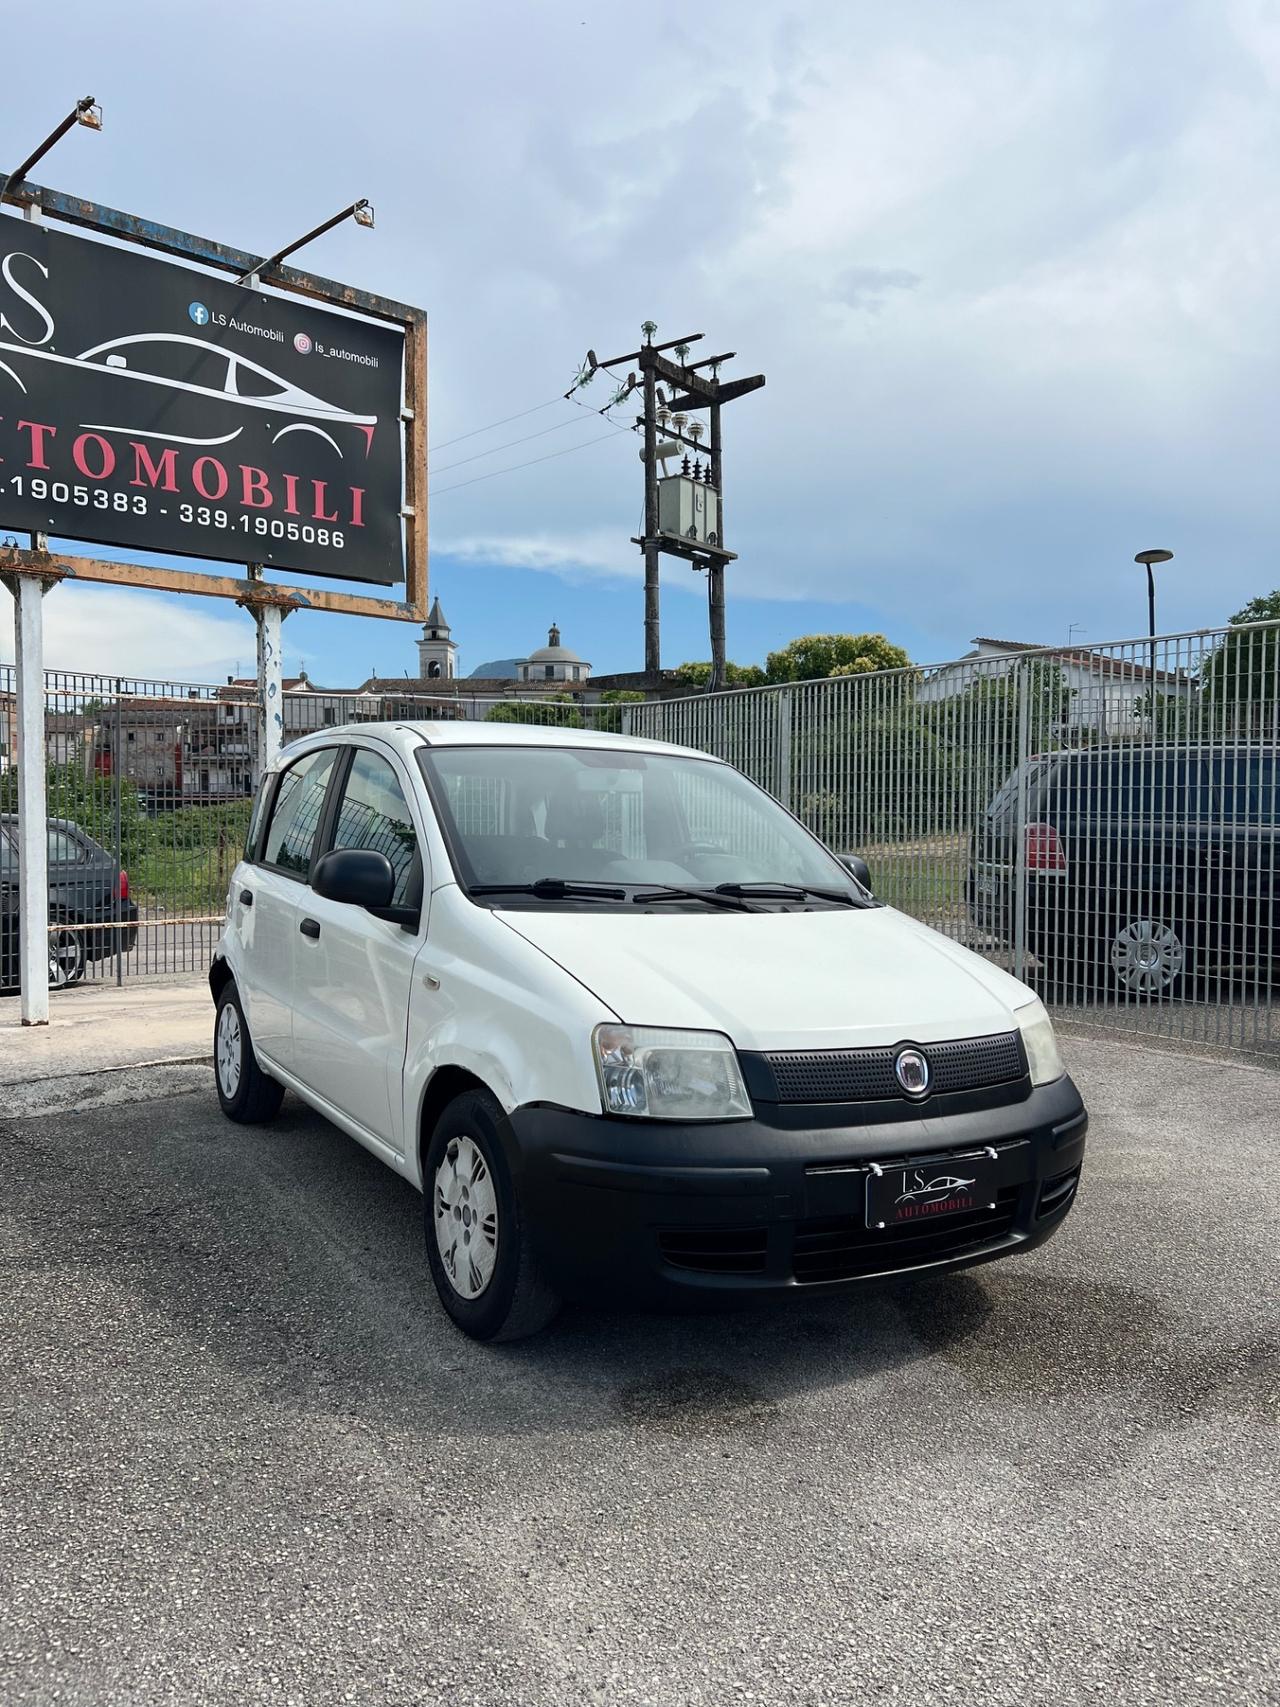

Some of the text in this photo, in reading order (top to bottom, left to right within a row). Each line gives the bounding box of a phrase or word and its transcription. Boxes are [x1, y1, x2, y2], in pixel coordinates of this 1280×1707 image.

[211, 310, 285, 344] LS Automobili
[314, 340, 379, 369] ls_automobili
[0, 415, 366, 527] TOMOBILI
[179, 503, 345, 549] 339.1905086
[896, 1196, 974, 1219] AUTOMOBILI
